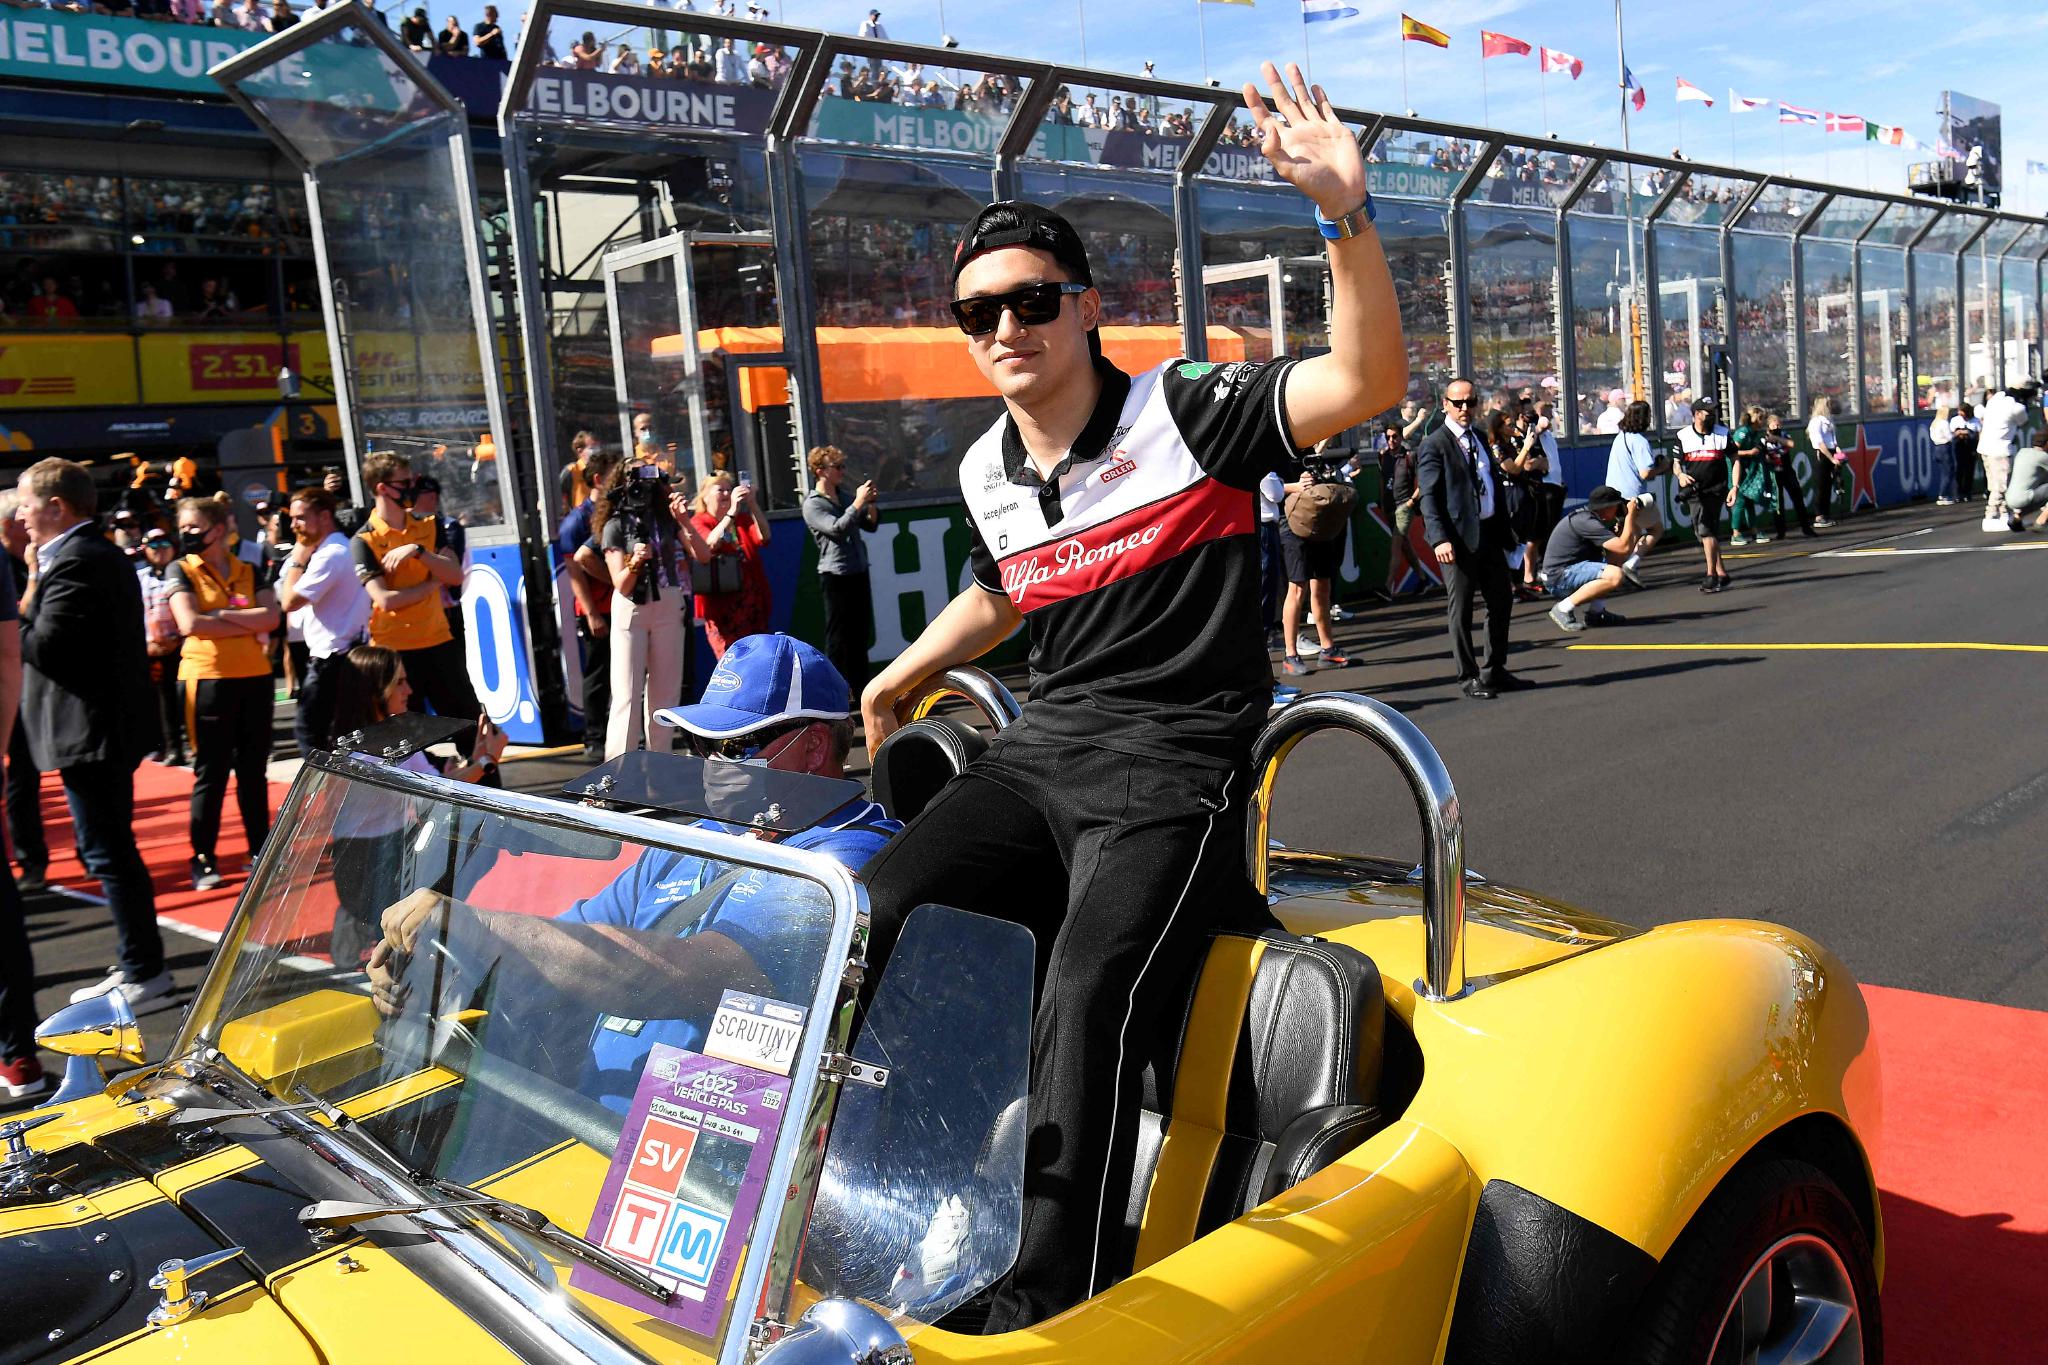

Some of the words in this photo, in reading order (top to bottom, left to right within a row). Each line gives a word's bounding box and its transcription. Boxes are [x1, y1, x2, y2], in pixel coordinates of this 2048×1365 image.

[0, 19, 311, 88] ELBOURE
[873, 113, 1048, 158] MELBOUE
[1142, 142, 1274, 180] MELOURNE
[1365, 171, 1450, 196] ELBOURNE
[1512, 187, 1596, 213] MELBONE
[299, 413, 317, 436] 3
[1103, 462, 1134, 482] ORLEN
[1003, 556, 1056, 604] Alfa
[1055, 523, 1164, 576] Romeo
[715, 1014, 796, 1051] SCRUTINY
[673, 1083, 717, 1107] VEHICLE
[717, 1099, 749, 1116] PASS
[692, 1070, 738, 1099] 2022
[762, 1097, 780, 1107] 3327
[639, 1138, 685, 1173] SV
[626, 1203, 657, 1245] T
[667, 1221, 712, 1265] M
